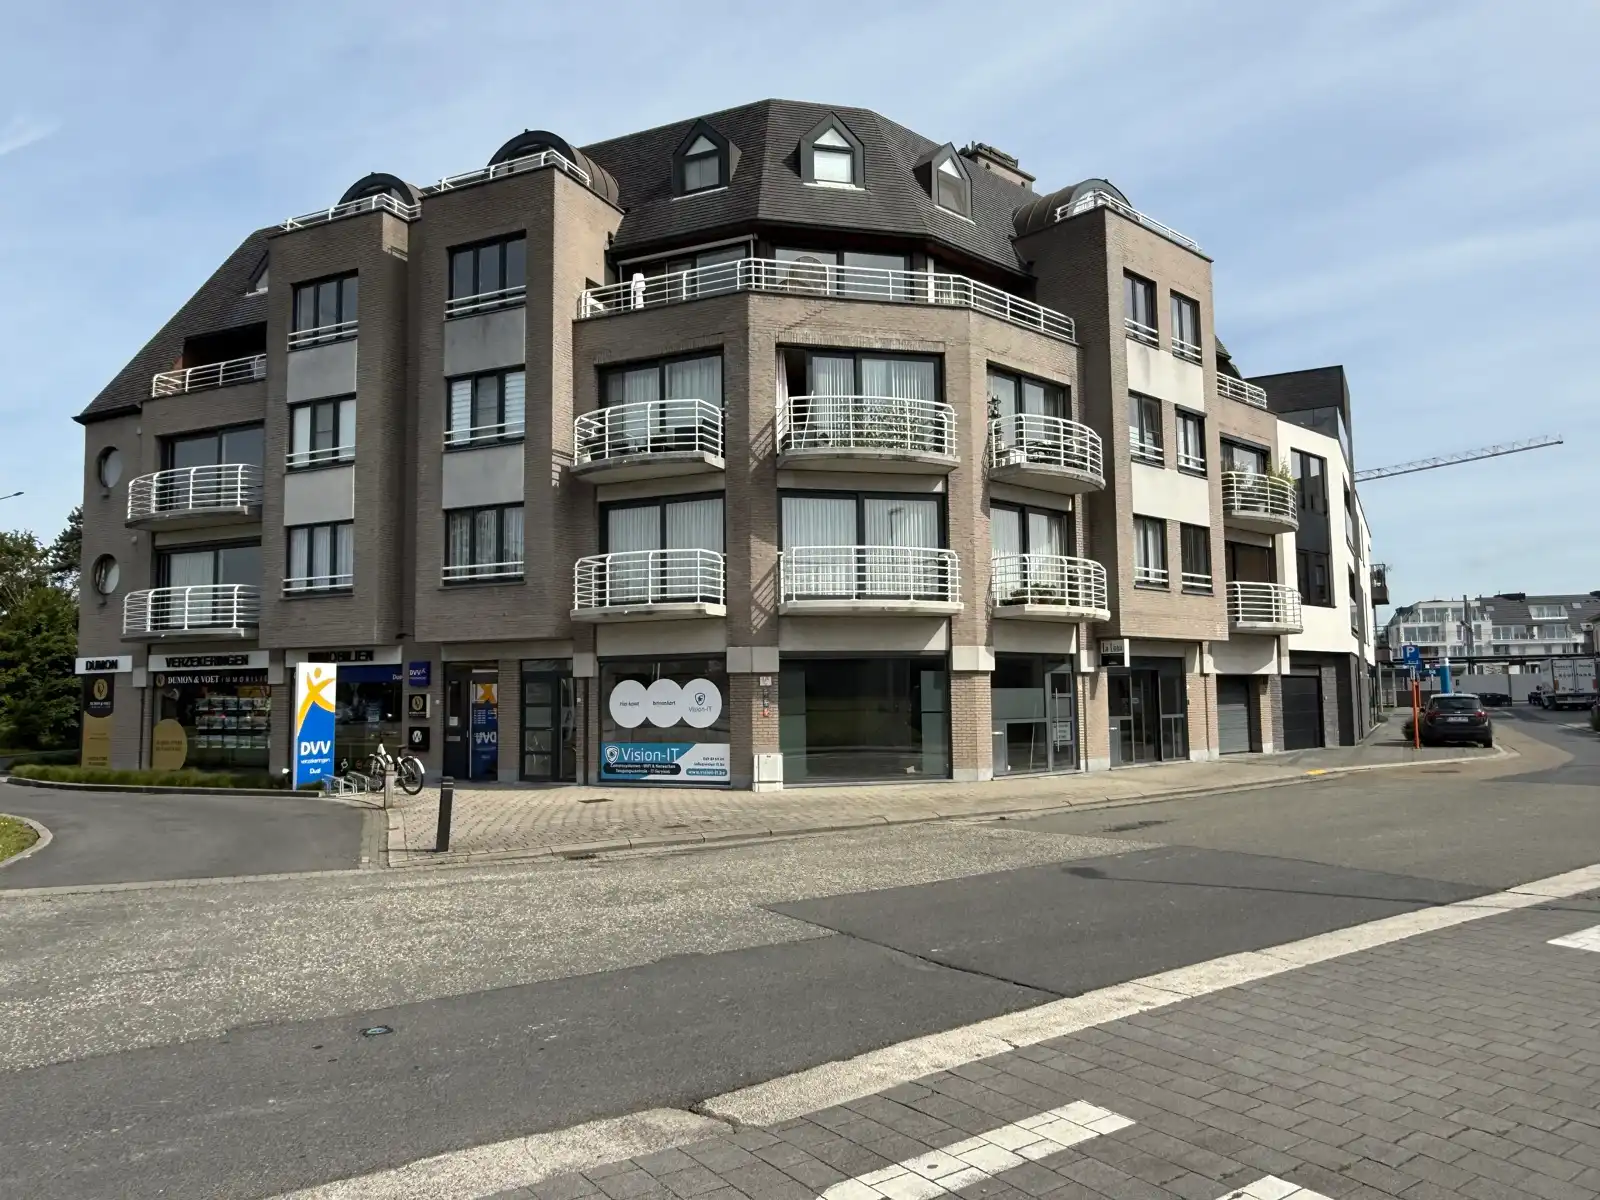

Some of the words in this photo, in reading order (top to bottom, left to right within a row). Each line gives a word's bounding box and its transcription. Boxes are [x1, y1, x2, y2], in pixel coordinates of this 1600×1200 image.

[308, 650, 374, 662] OBILIEN
[1406, 646, 1415, 658] P
[85, 659, 118, 670] DUMON
[165, 654, 249, 667] VERZEKERINGEN
[167, 676, 193, 684] DUMON
[193, 676, 200, 684] &
[201, 675, 219, 684] VOET
[300, 740, 331, 756] DVV
[621, 747, 680, 762] Vision-IT
